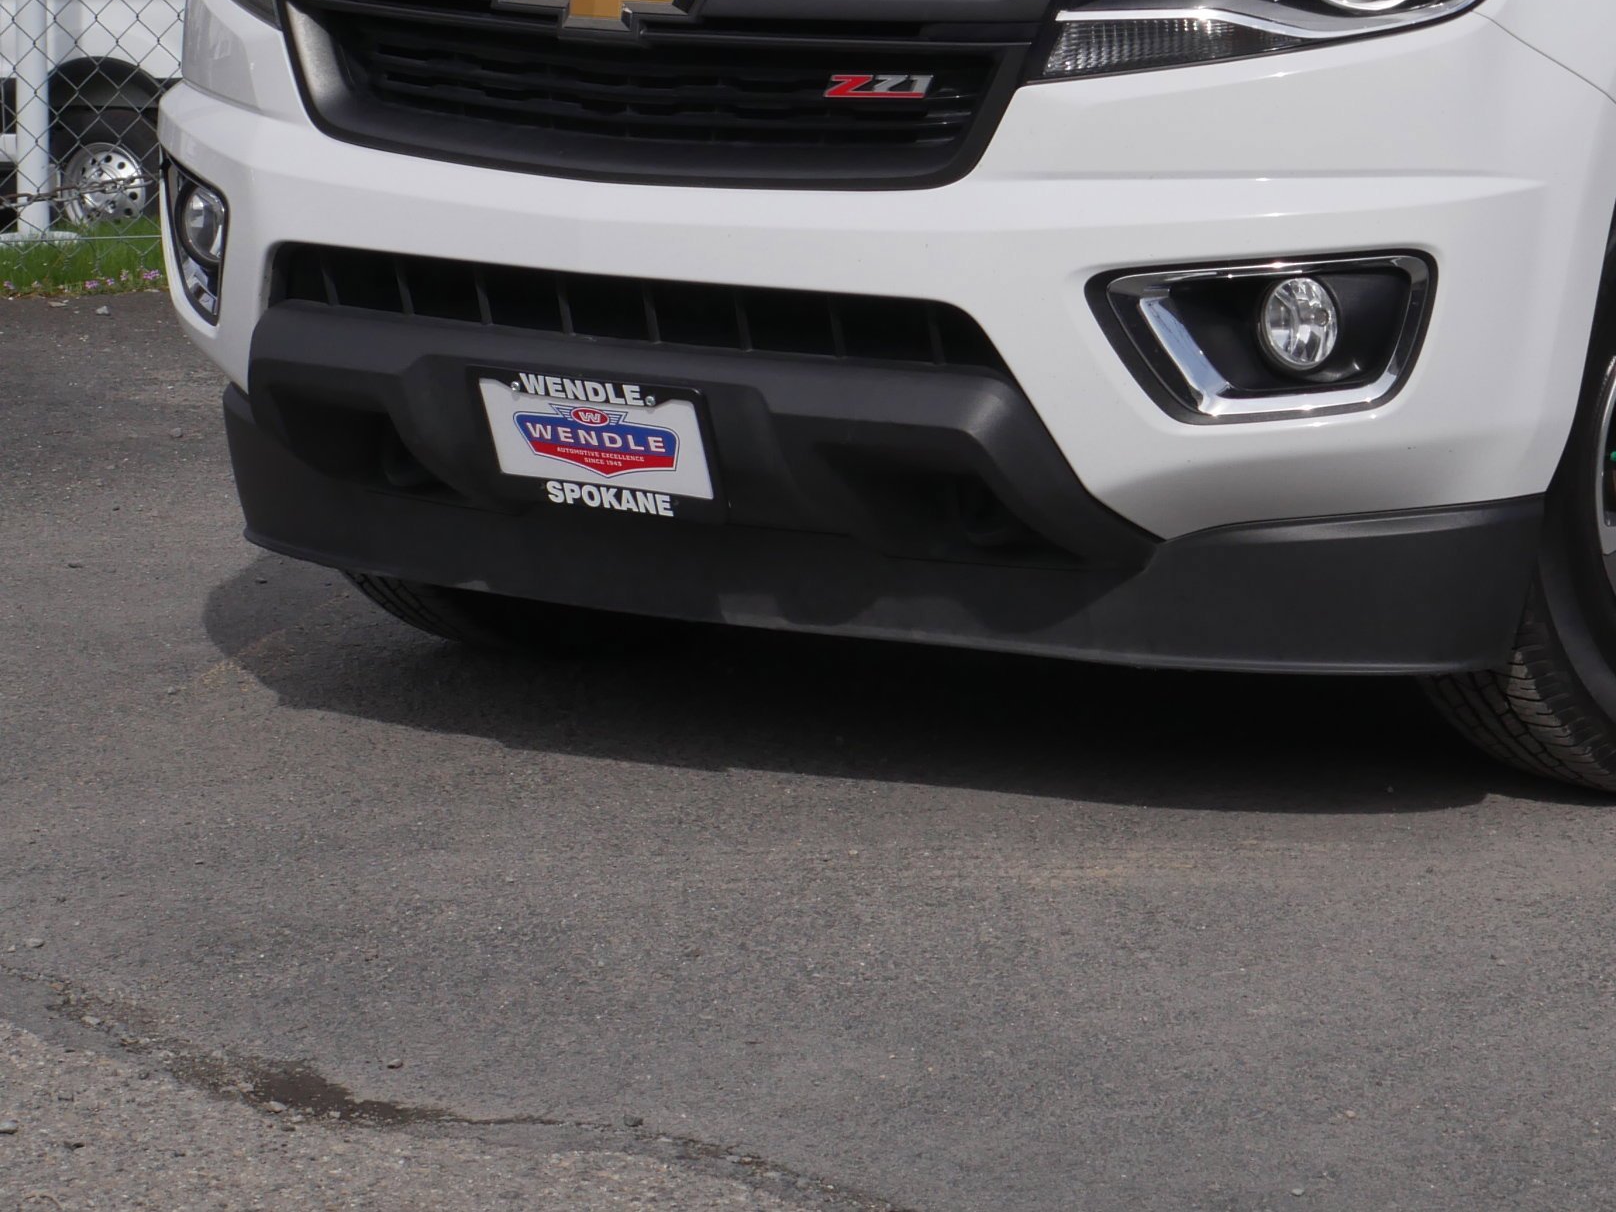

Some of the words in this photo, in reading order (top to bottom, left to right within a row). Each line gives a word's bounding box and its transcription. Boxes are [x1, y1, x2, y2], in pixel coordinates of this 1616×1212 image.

[823, 74, 934, 99] Z71
[519, 372, 645, 406] WENDLE
[526, 422, 667, 453] WENDLE
[556, 446, 600, 457] AUTOMOTIVE
[600, 451, 645, 462] EXCELLENCE
[584, 457, 605, 465] SINCE
[546, 480, 674, 517] SPOKANE
